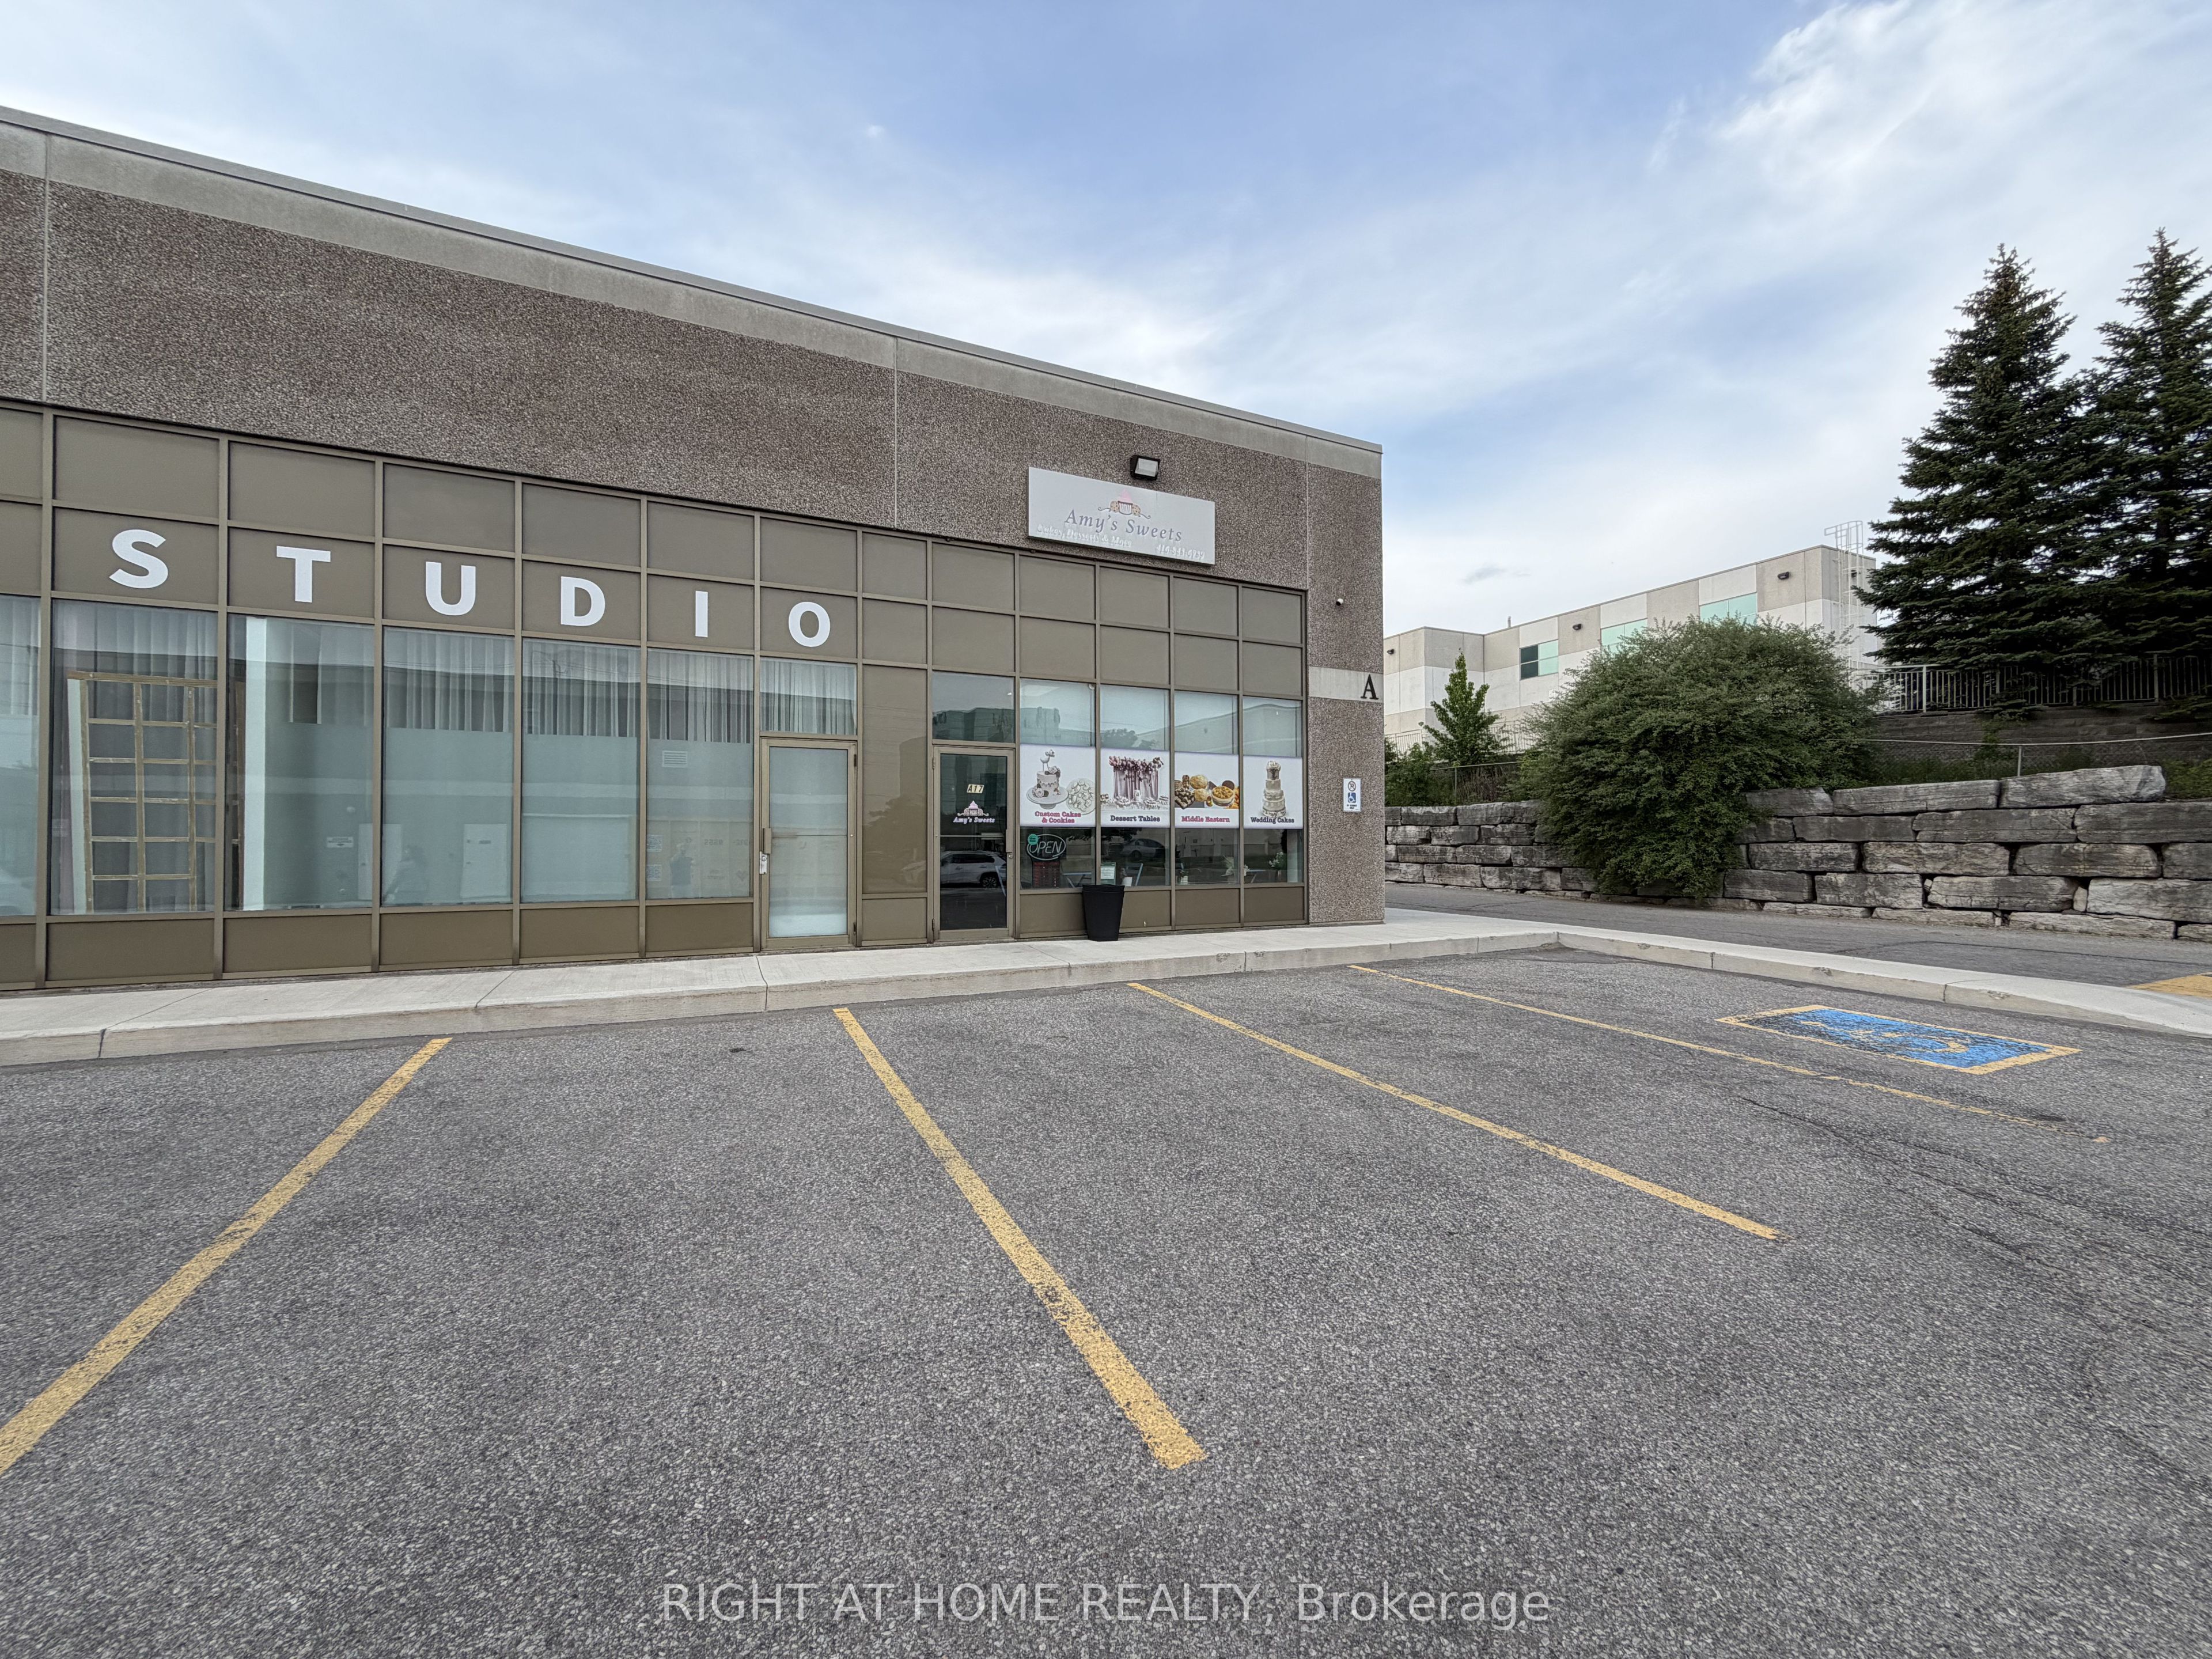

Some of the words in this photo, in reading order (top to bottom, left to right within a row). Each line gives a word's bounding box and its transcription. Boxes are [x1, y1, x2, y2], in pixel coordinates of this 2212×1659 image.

[1065, 509, 1118, 533] Amy's
[1126, 519, 1182, 541] Sweets
[109, 529, 831, 647] STUDIO
[1360, 673, 1379, 700] A
[968, 785, 983, 793] A17
[1029, 840, 1062, 854] OPEN
